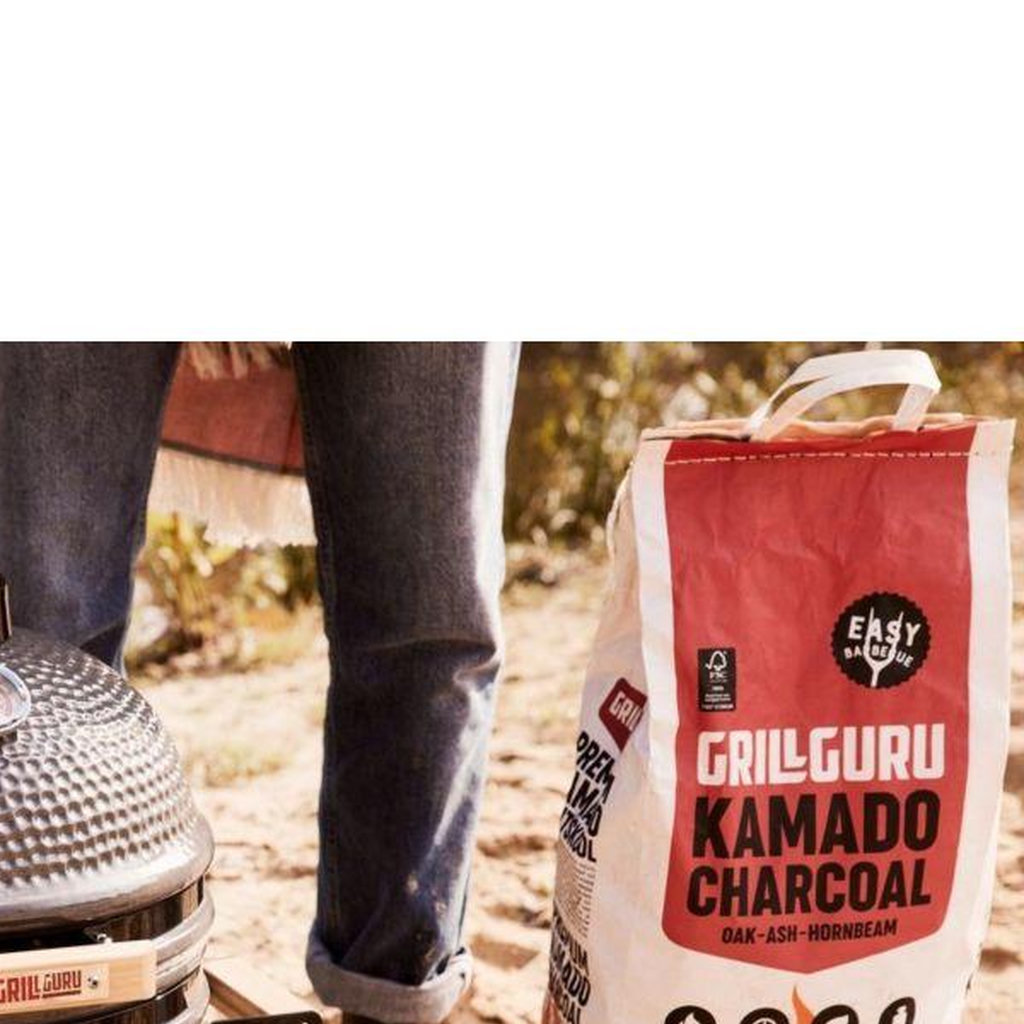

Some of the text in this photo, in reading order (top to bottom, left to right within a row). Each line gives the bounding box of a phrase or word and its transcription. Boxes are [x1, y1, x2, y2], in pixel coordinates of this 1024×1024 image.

[848, 615, 921, 647] EASY
[844, 644, 914, 668] BABEUE
[692, 789, 941, 859] KAMADO
[686, 858, 932, 917] CHARCOAL
[43, 970, 81, 992] GURU
